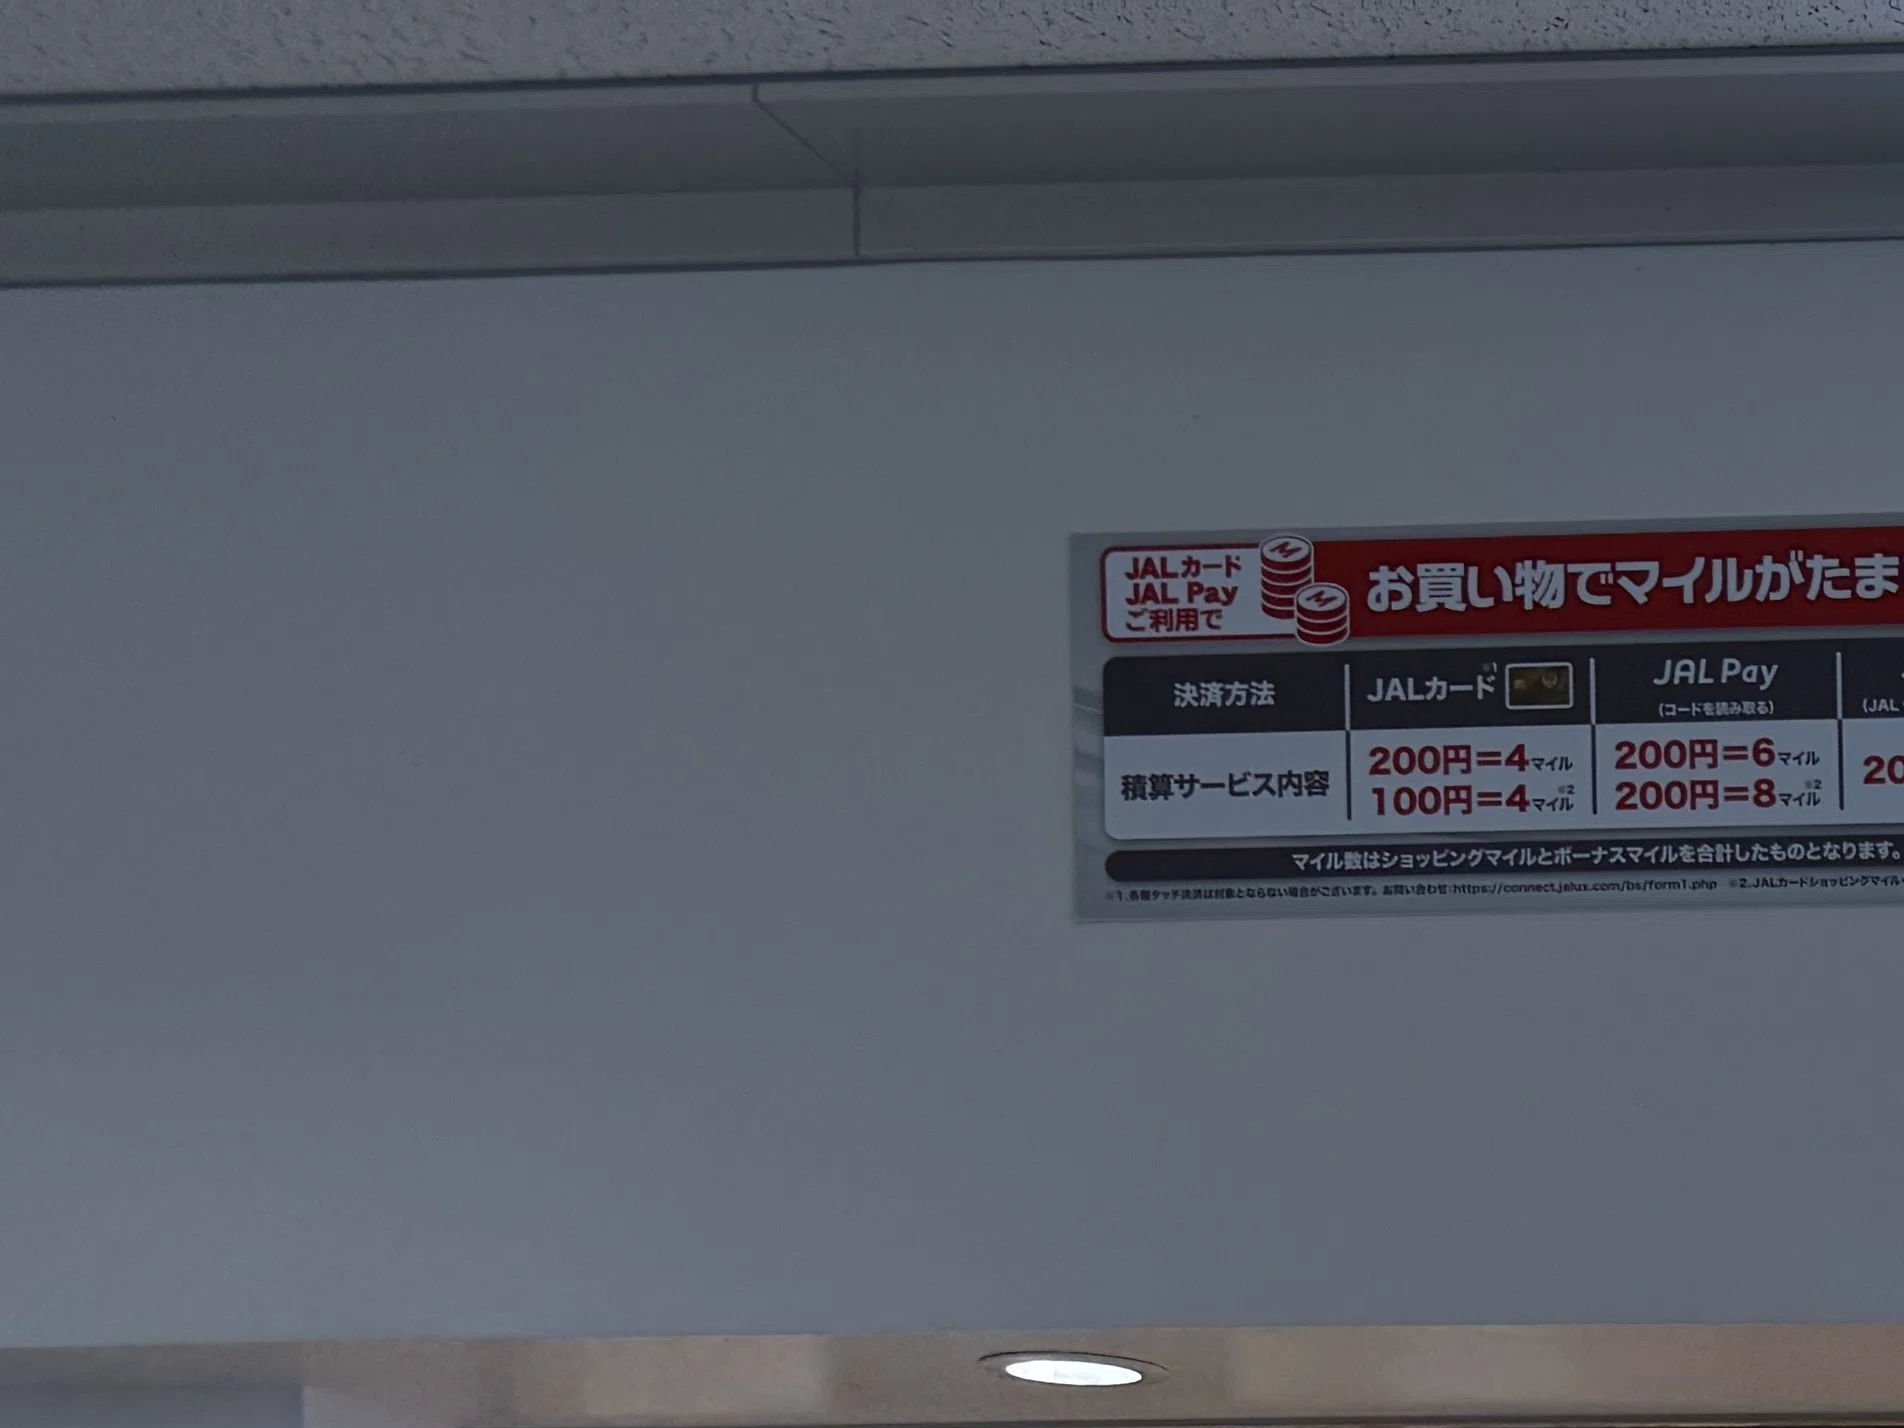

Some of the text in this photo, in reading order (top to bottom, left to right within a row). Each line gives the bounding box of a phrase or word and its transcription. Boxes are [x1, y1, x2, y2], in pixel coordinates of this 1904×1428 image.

[1124, 554, 1242, 579] JALカード
[1126, 581, 1238, 609] JAL Pay
[1126, 609, 1223, 633] ご利用で
[1654, 657, 1779, 690] JAL Pay
[1175, 680, 1276, 709] 決済方法
[1121, 770, 1331, 804] 積算サービス内容
